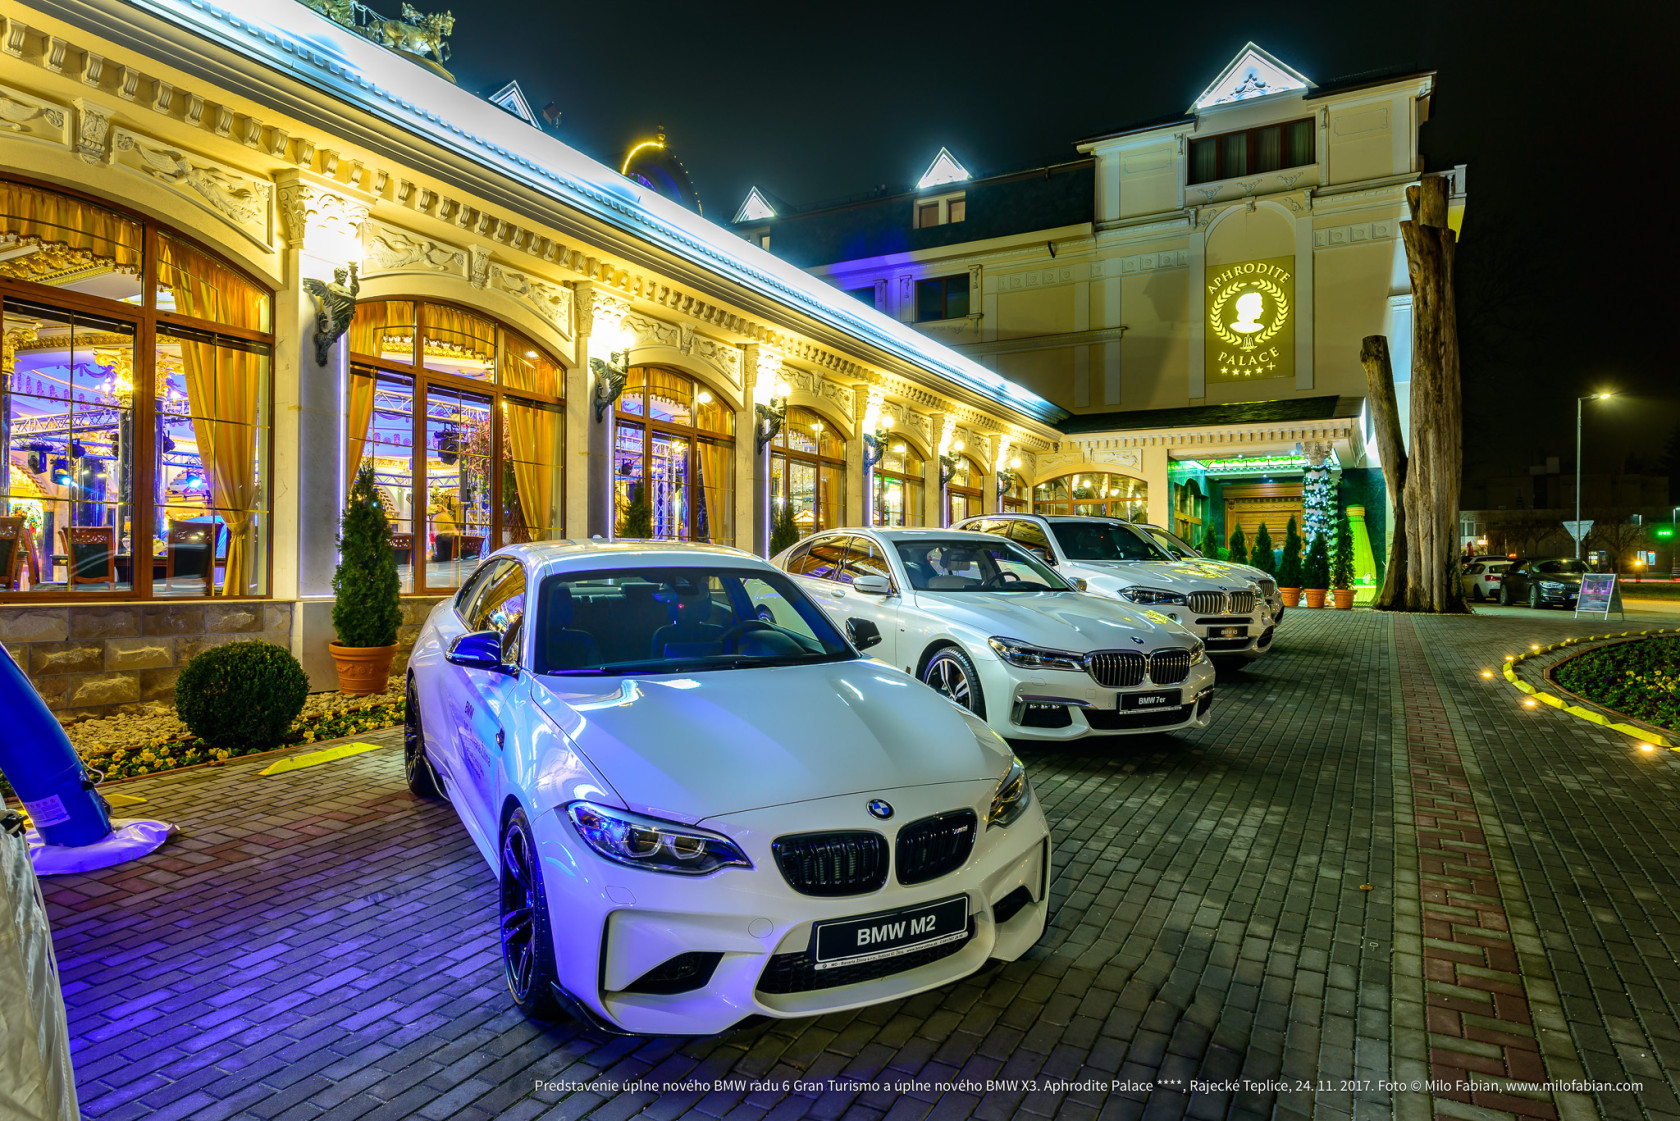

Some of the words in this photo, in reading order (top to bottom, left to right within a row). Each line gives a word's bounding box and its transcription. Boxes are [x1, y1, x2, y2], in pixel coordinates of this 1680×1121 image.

[1208, 263, 1291, 295] APHRODITE
[1218, 346, 1280, 366] PALACE
[1138, 696, 1156, 705] BMW
[856, 920, 907, 946] BMW
[910, 914, 936, 936] M2
